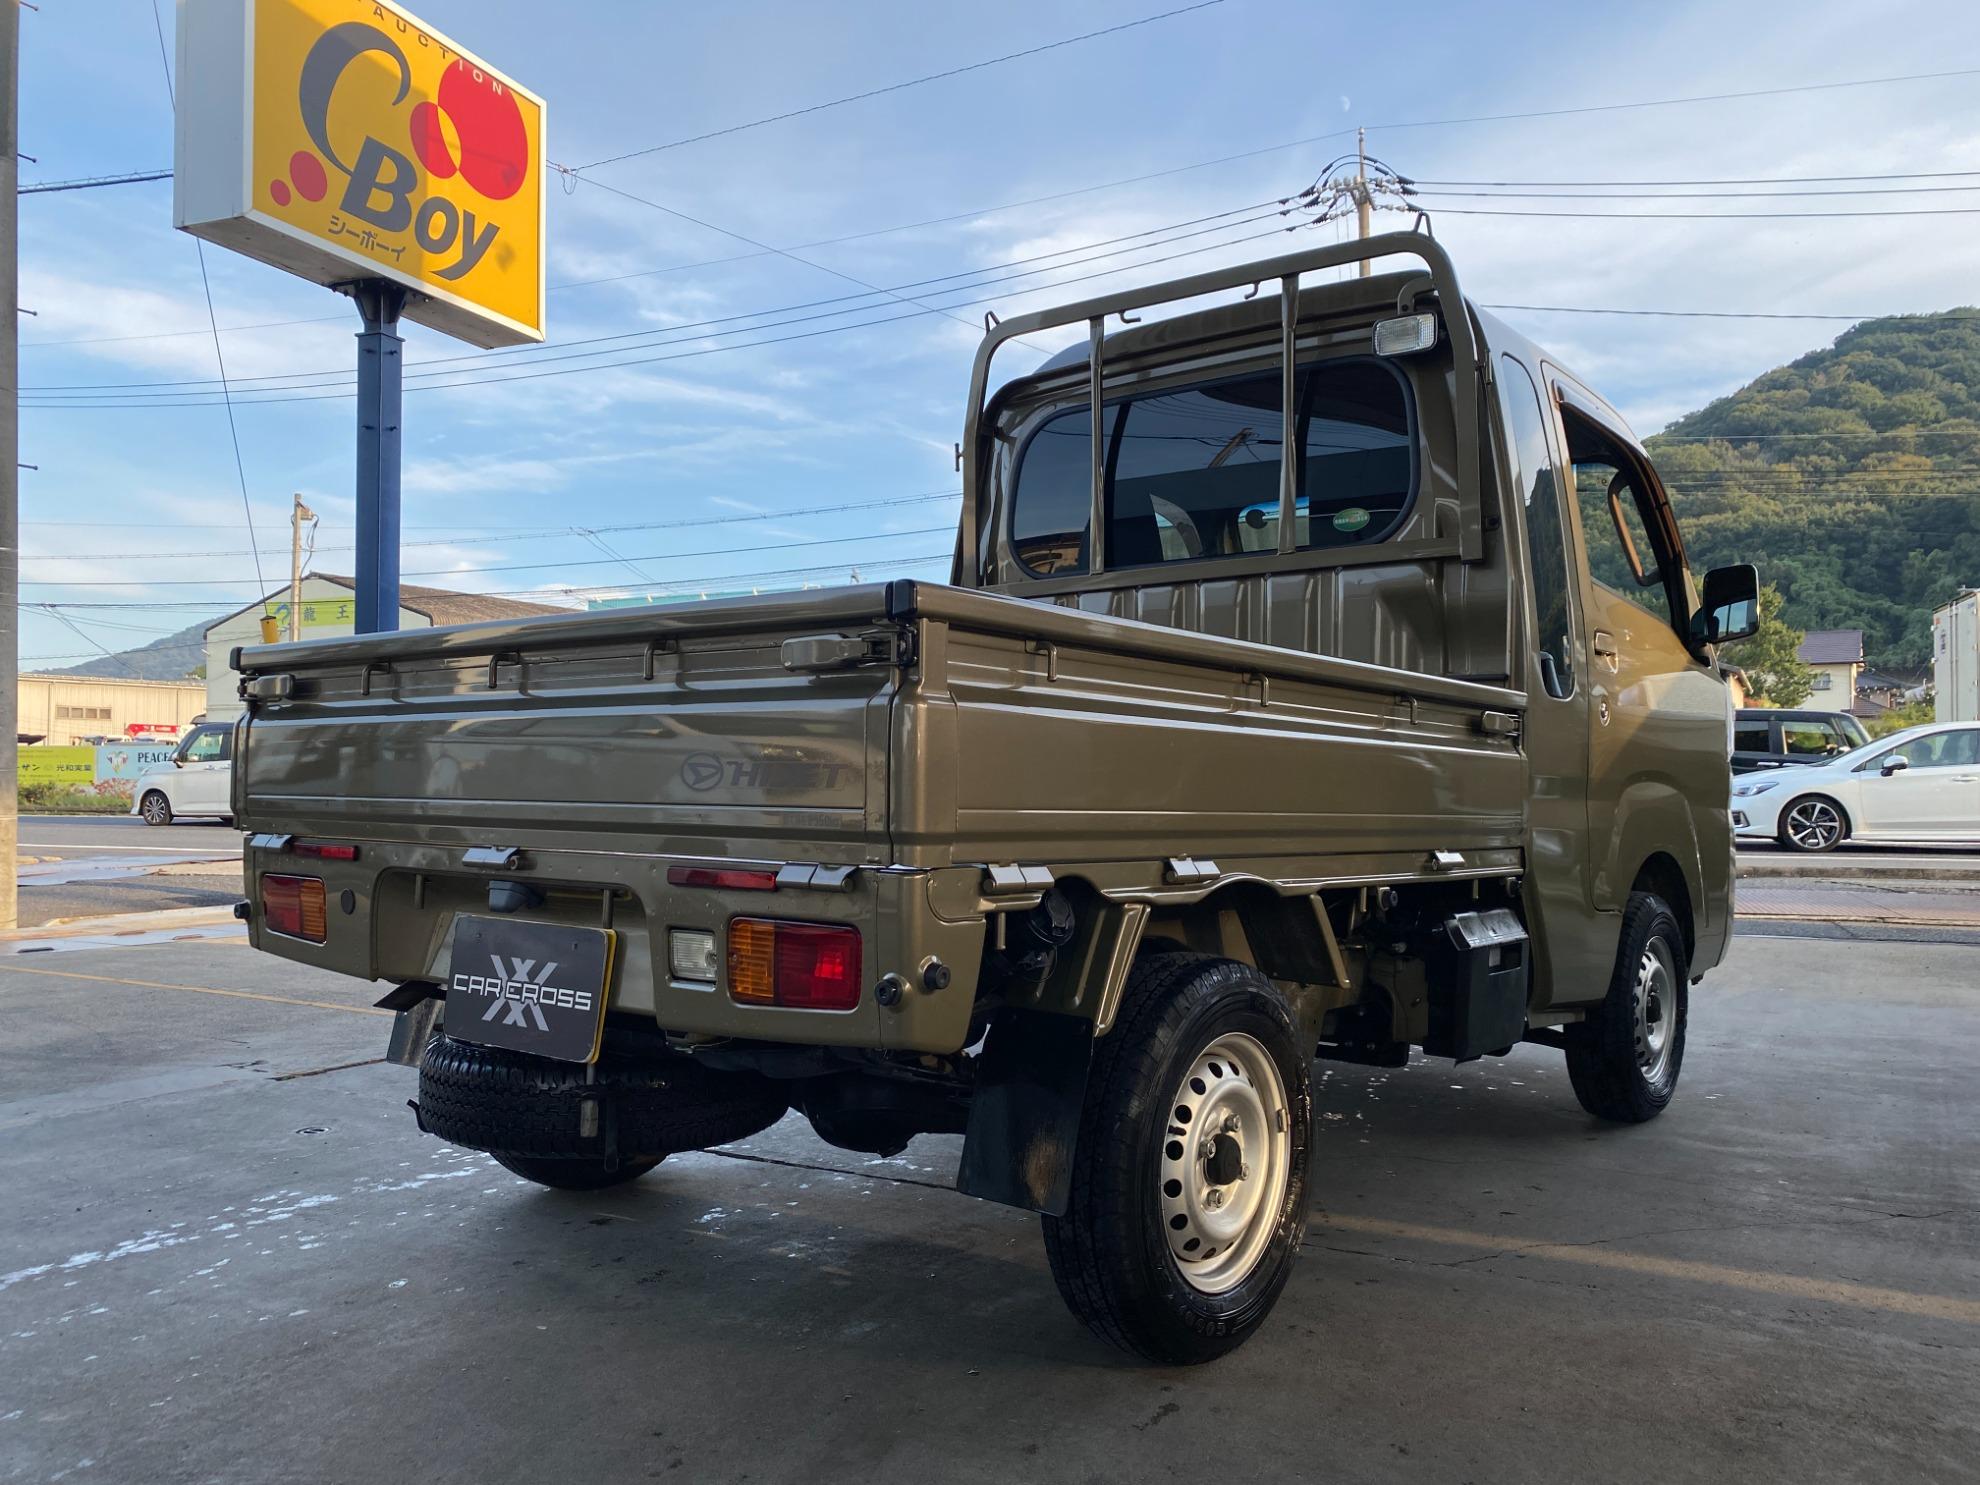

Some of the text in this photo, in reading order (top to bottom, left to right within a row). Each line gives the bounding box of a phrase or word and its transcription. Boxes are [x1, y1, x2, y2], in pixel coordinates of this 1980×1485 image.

[372, 5, 503, 96] AUCTION
[328, 215, 406, 262] シーボーイ
[726, 761, 849, 789] HIET
[453, 973, 592, 1011] CAR CROSS
